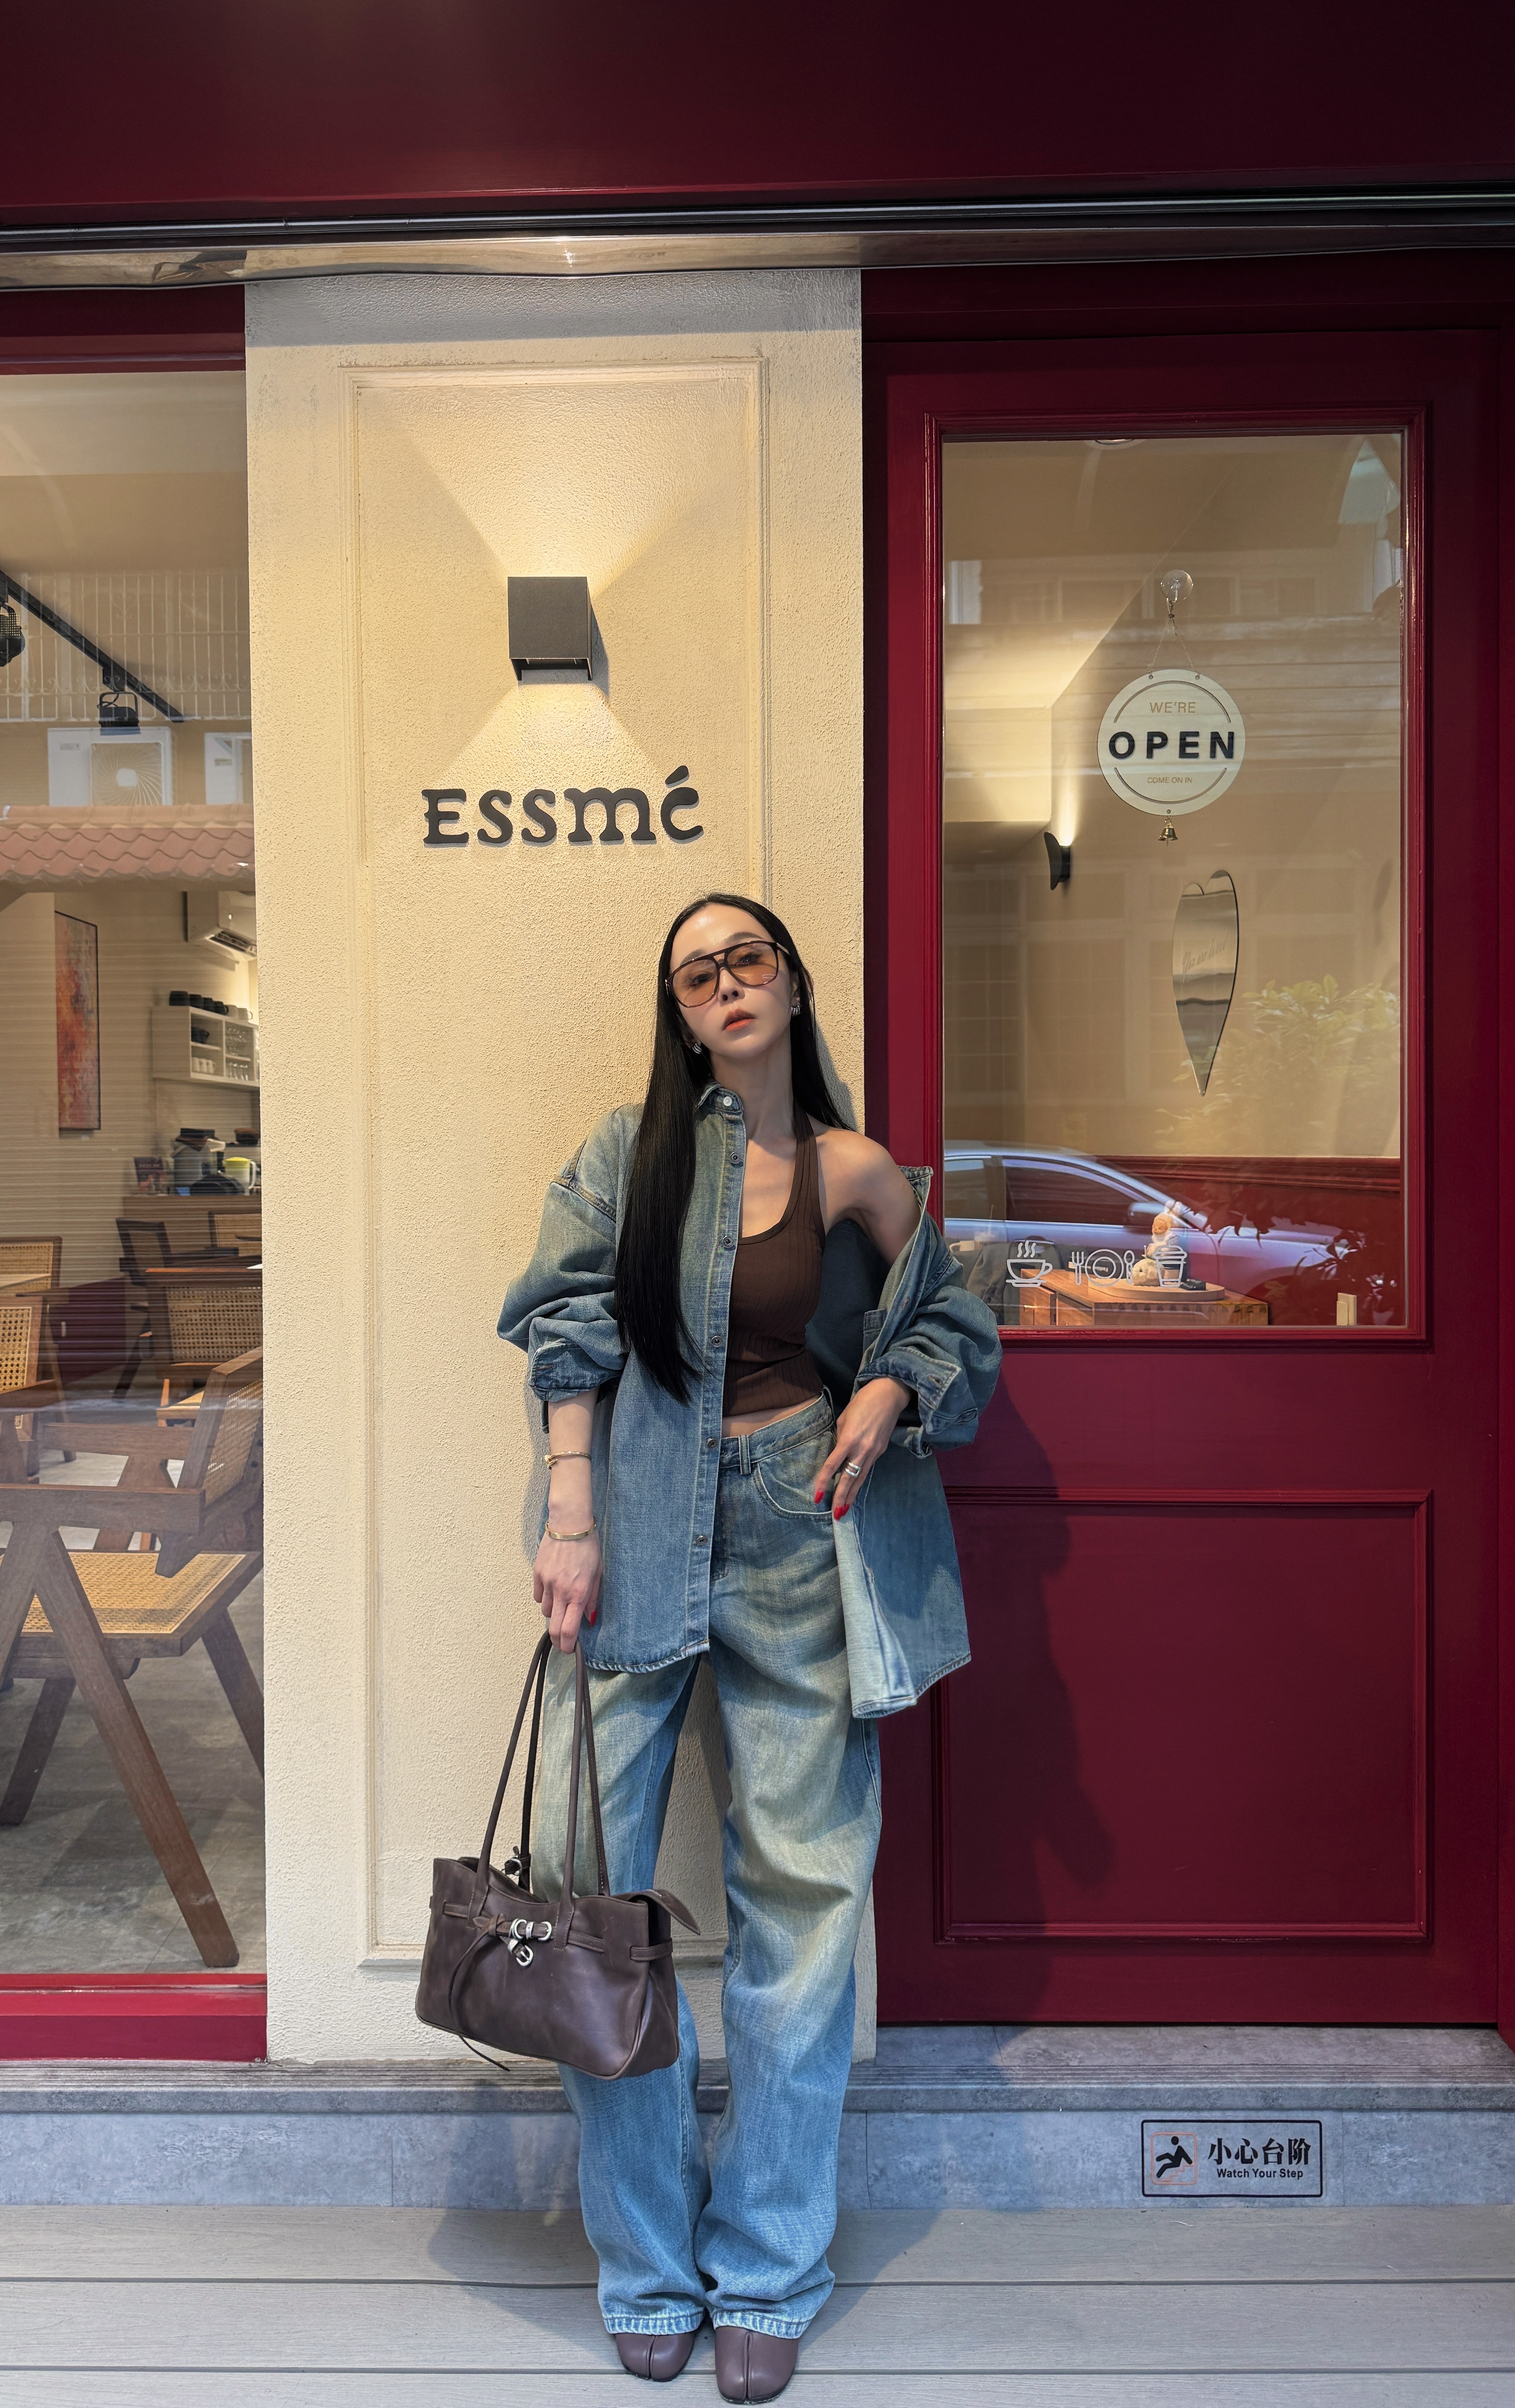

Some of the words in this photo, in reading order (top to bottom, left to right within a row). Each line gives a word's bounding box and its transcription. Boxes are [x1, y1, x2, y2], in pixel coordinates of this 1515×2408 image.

[1150, 702, 1196, 714] WE'RE
[1108, 731, 1234, 760] OPEN
[1208, 2137, 1312, 2165] 小心台阶
[1217, 2168, 1249, 2178] Watch
[1252, 2168, 1277, 2178] Your
[1279, 2168, 1303, 2180] Step
